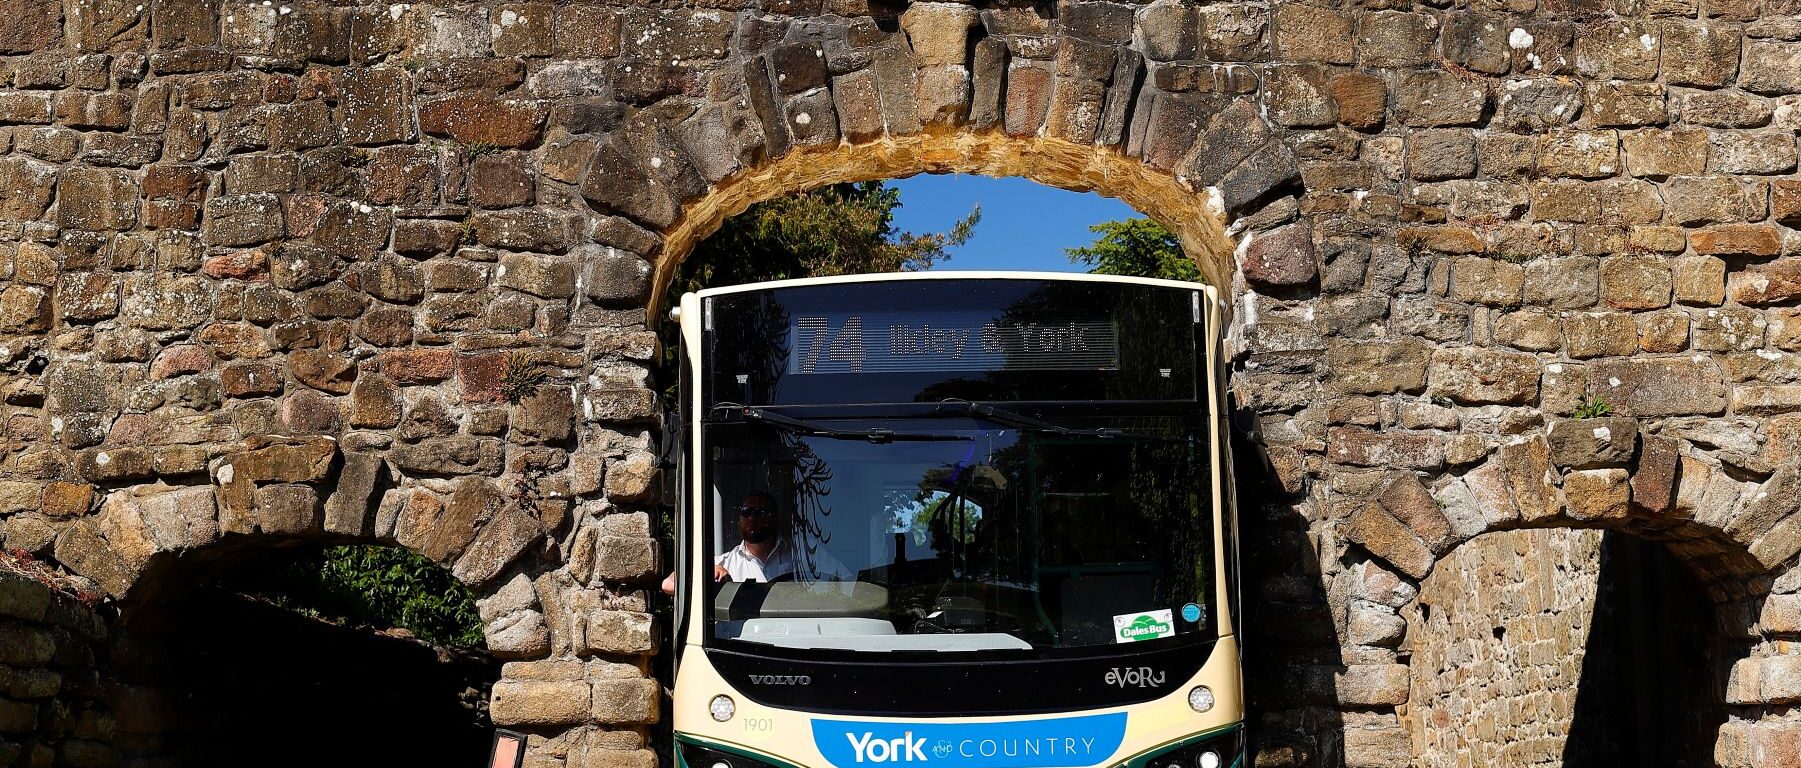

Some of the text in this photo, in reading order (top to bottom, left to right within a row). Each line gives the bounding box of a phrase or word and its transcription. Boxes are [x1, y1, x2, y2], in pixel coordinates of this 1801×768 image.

[798, 317, 1090, 372] 74 Ilkley & York
[1122, 623, 1167, 637] Dales Bus
[749, 674, 811, 685] VOLVO
[743, 718, 773, 731] 1901
[845, 731, 928, 762] York
[959, 737, 1095, 758] COUNTRY
